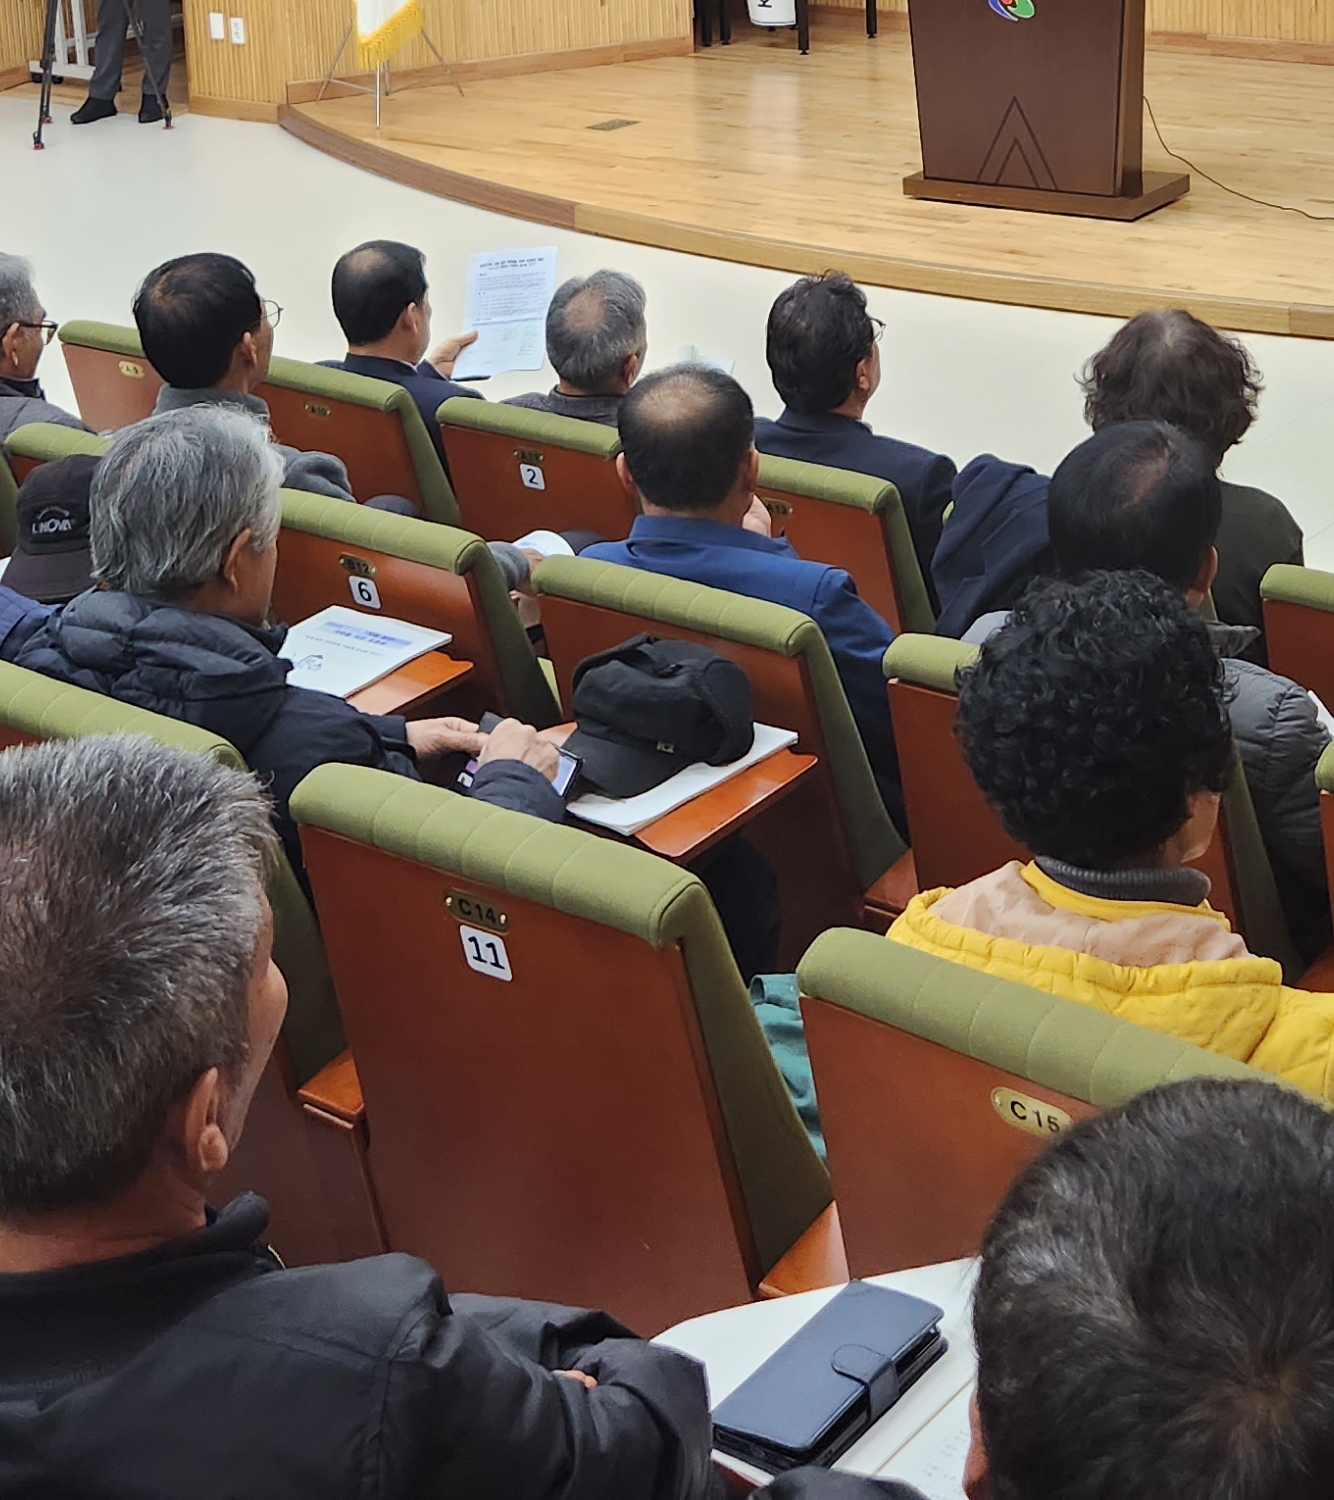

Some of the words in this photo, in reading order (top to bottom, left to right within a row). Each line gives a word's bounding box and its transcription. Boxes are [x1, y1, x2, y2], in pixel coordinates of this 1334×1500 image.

[526, 468, 539, 485] 2
[357, 581, 373, 602] 6
[458, 898, 497, 924] C14
[467, 936, 506, 970] 11
[1010, 1100, 1061, 1133] C15
